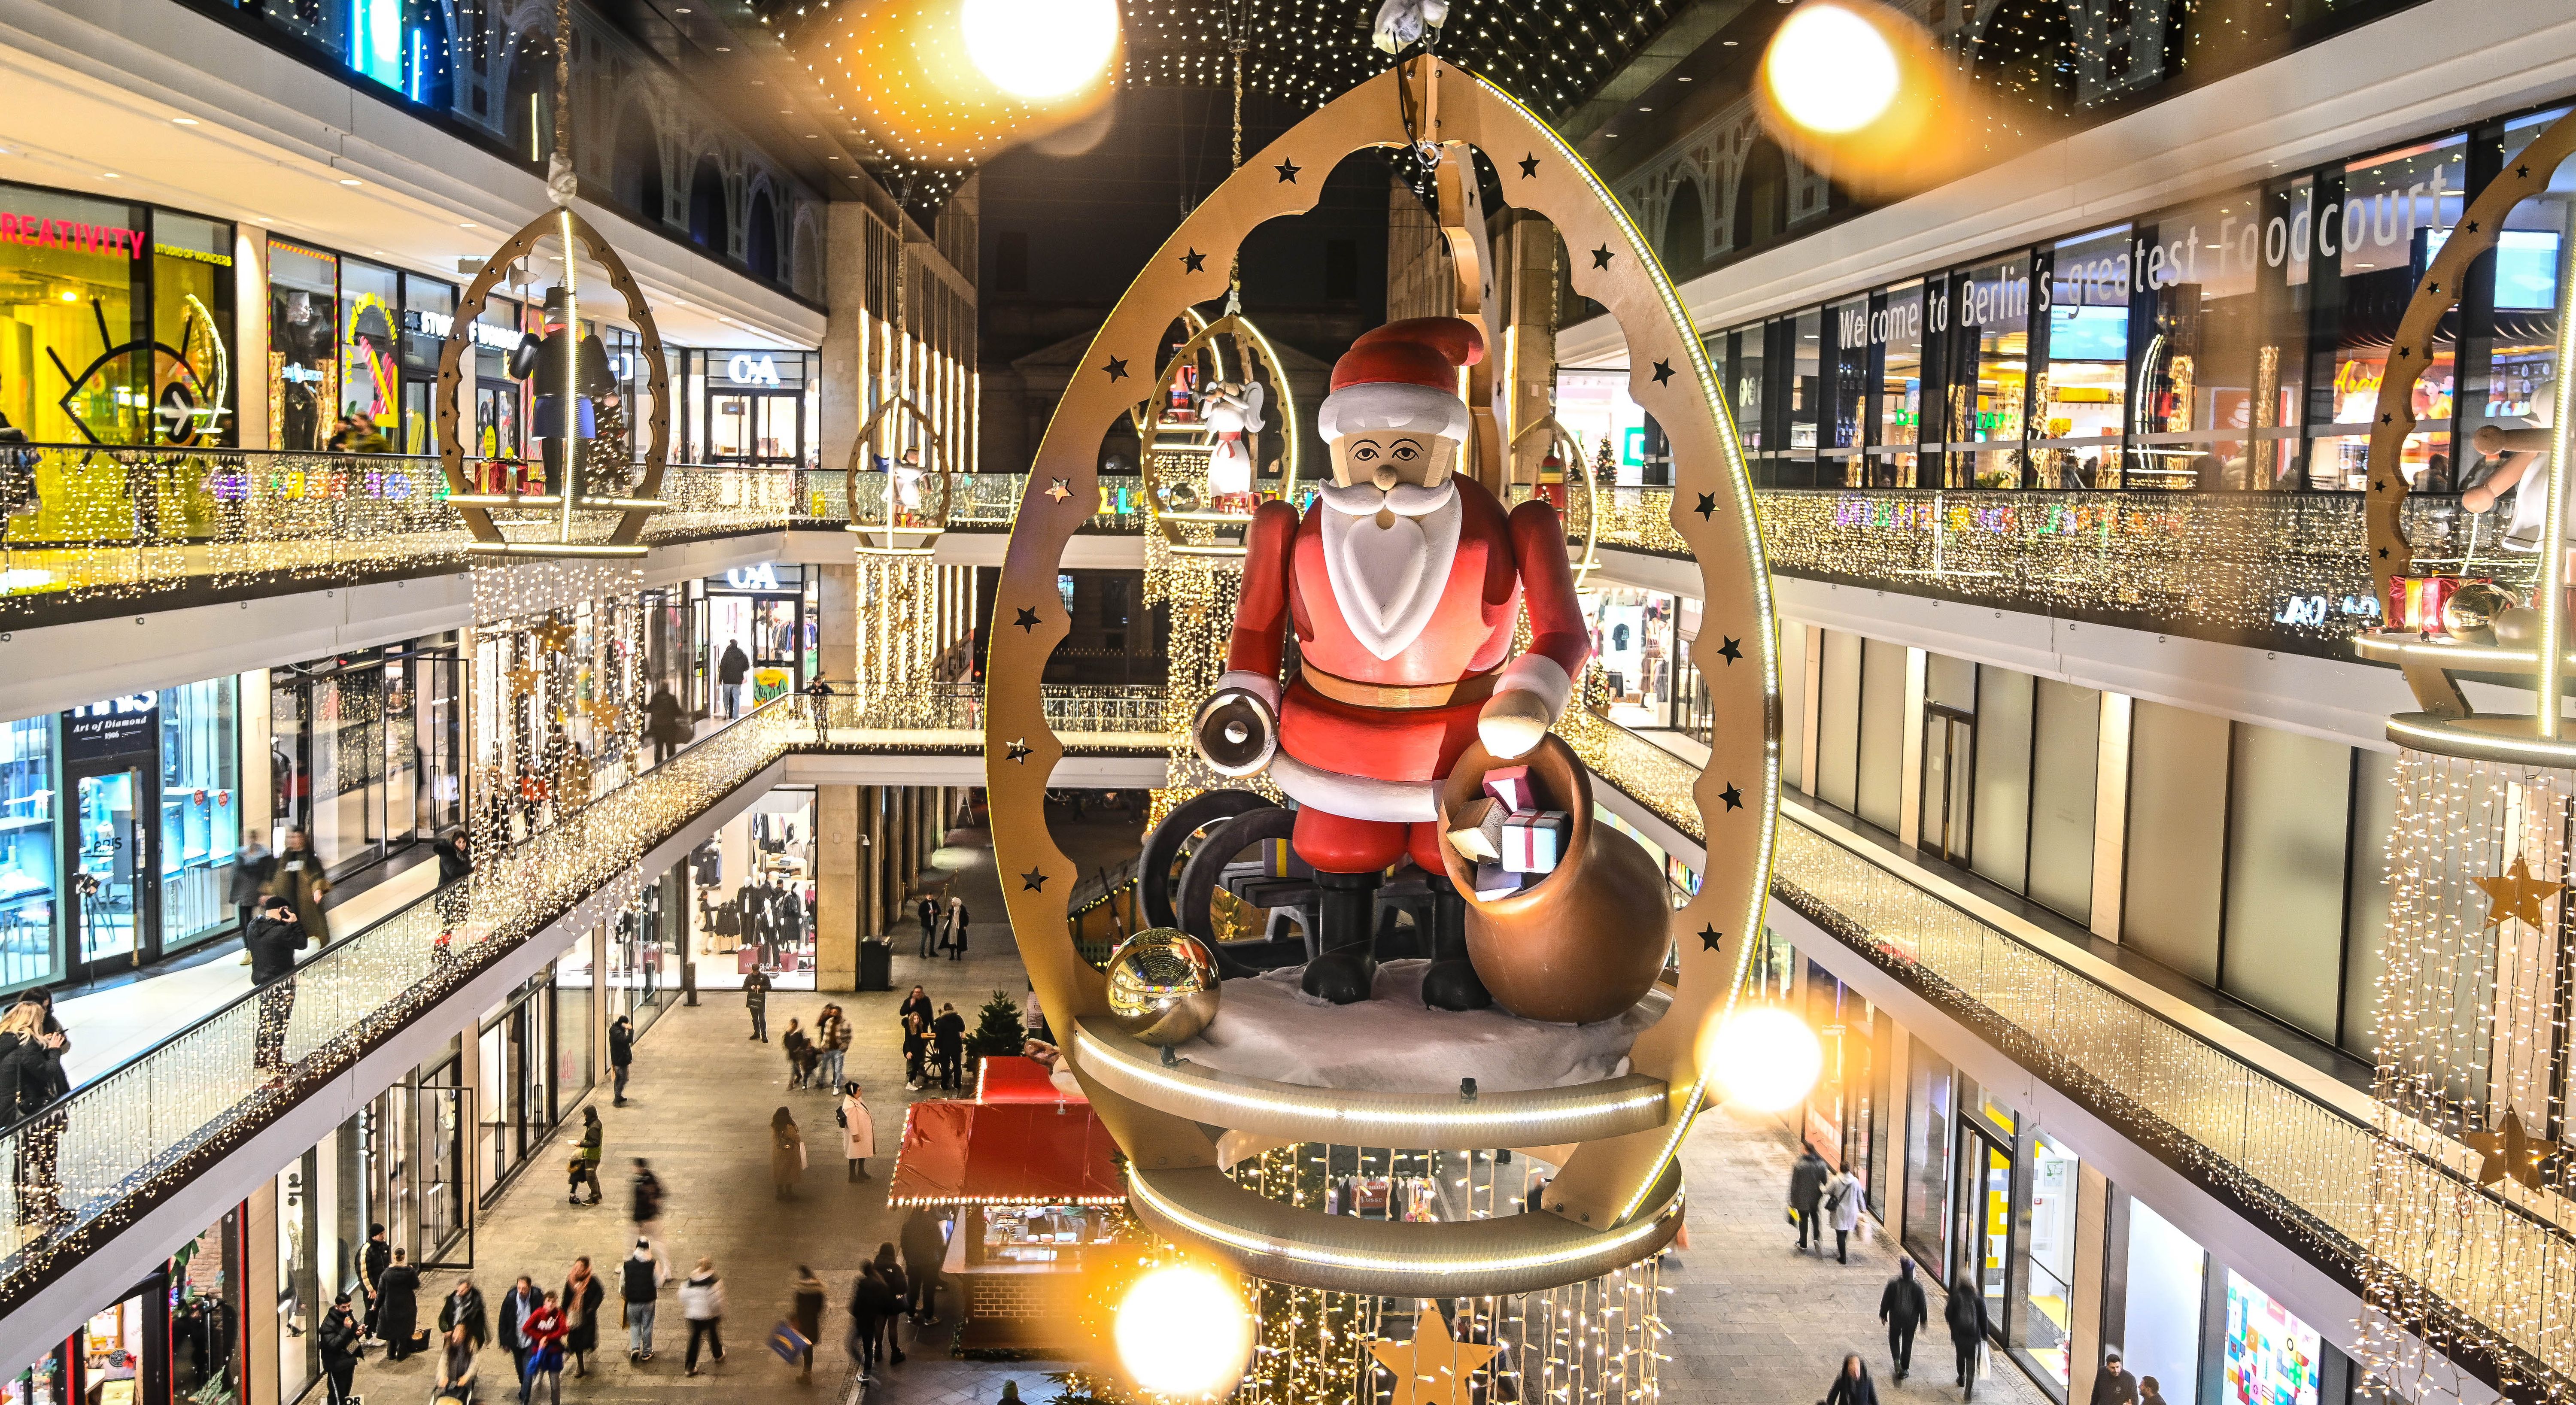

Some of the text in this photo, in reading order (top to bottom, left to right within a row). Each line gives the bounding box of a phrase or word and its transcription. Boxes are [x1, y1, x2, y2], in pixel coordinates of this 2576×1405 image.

[0, 212, 145, 260] REATIVITY
[1840, 164, 2447, 351] Welcome to Berlin's greatest Foodcourt
[73, 716, 147, 733] Art of Diamond
